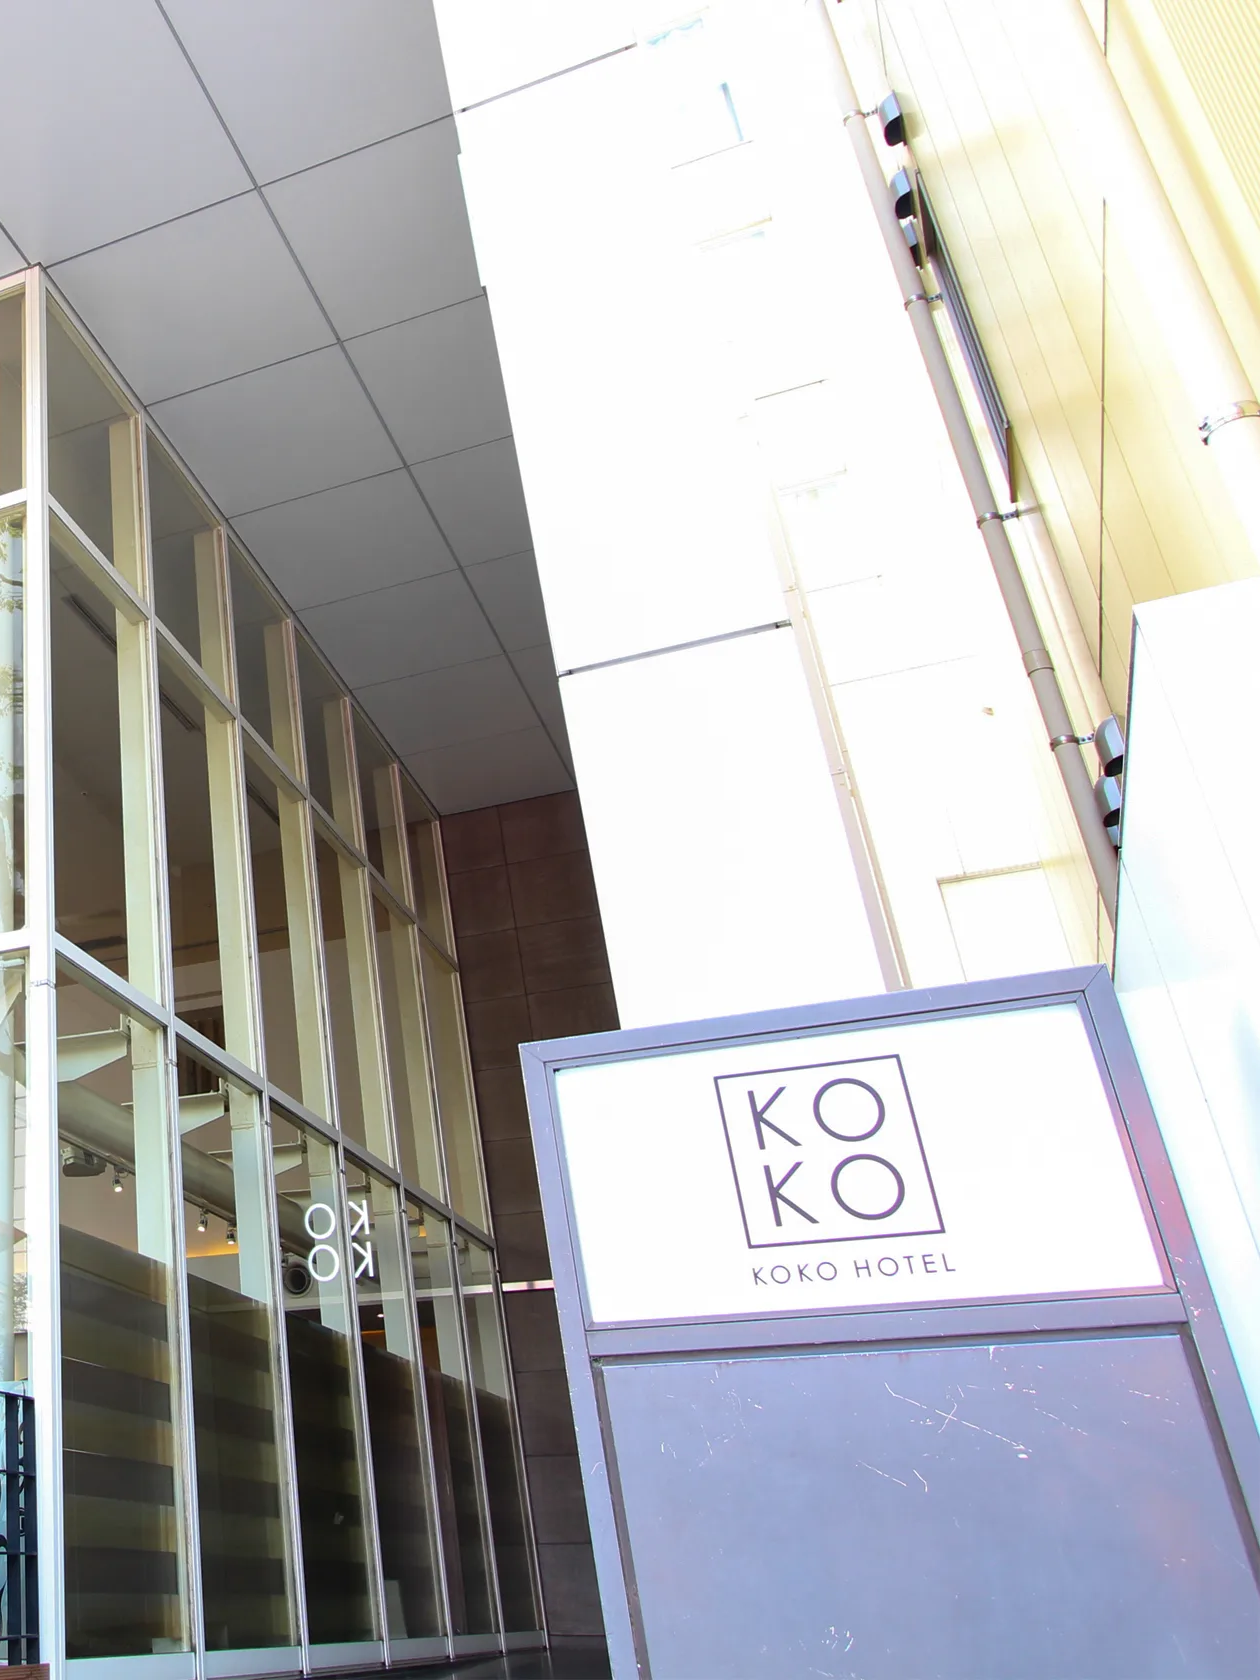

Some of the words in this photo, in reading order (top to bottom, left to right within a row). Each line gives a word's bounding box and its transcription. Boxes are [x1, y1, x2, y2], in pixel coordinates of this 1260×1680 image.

[747, 1077, 886, 1150] KO
[763, 1153, 906, 1227] KO
[752, 1261, 838, 1286] KOKO
[853, 1253, 956, 1279] HOTEL
